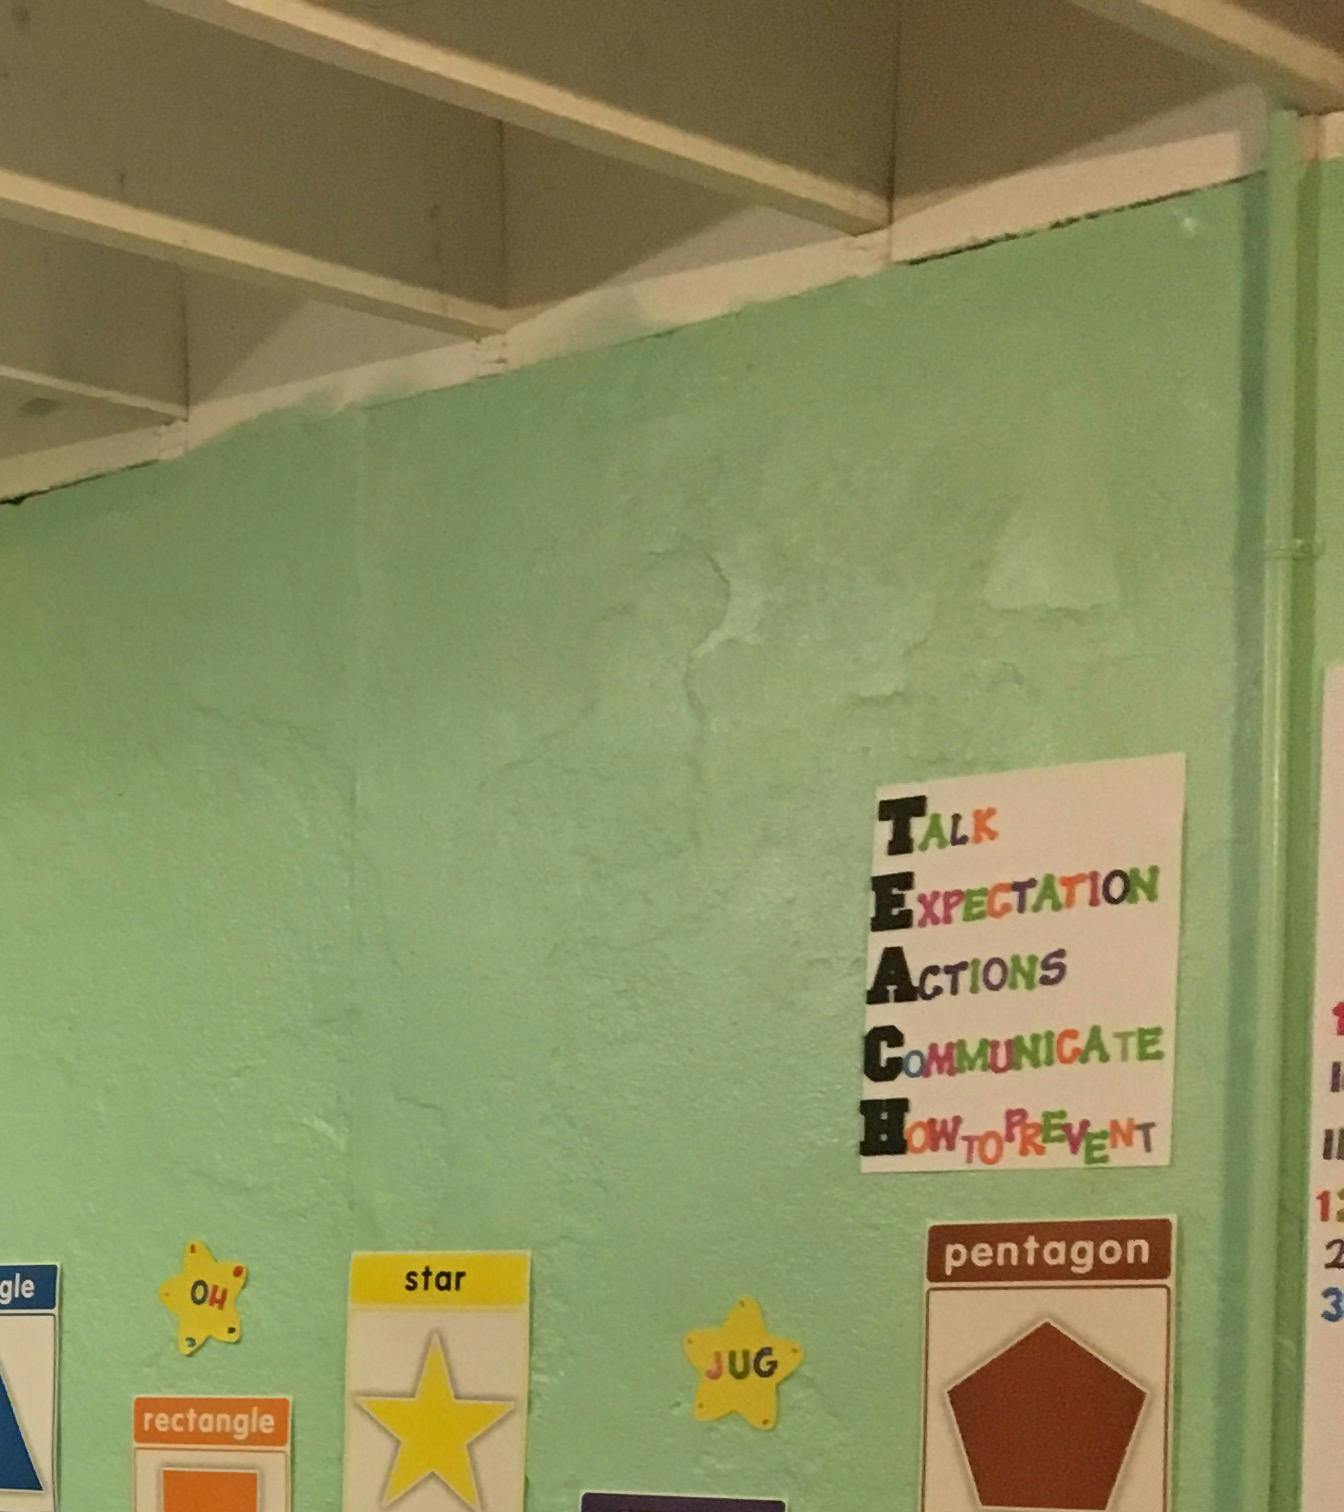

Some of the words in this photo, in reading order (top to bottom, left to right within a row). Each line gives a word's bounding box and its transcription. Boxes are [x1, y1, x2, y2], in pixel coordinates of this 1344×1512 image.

[878, 795, 999, 856] TALK
[870, 864, 1160, 933] EXPECTATION
[866, 946, 1068, 1005] ACTIONS
[863, 1024, 1165, 1083] COMMUNICATE
[404, 1266, 467, 1292] star
[945, 1233, 1151, 1276] pentagon
[704, 1346, 779, 1382] JUG
[142, 1406, 275, 1441] rectangle
